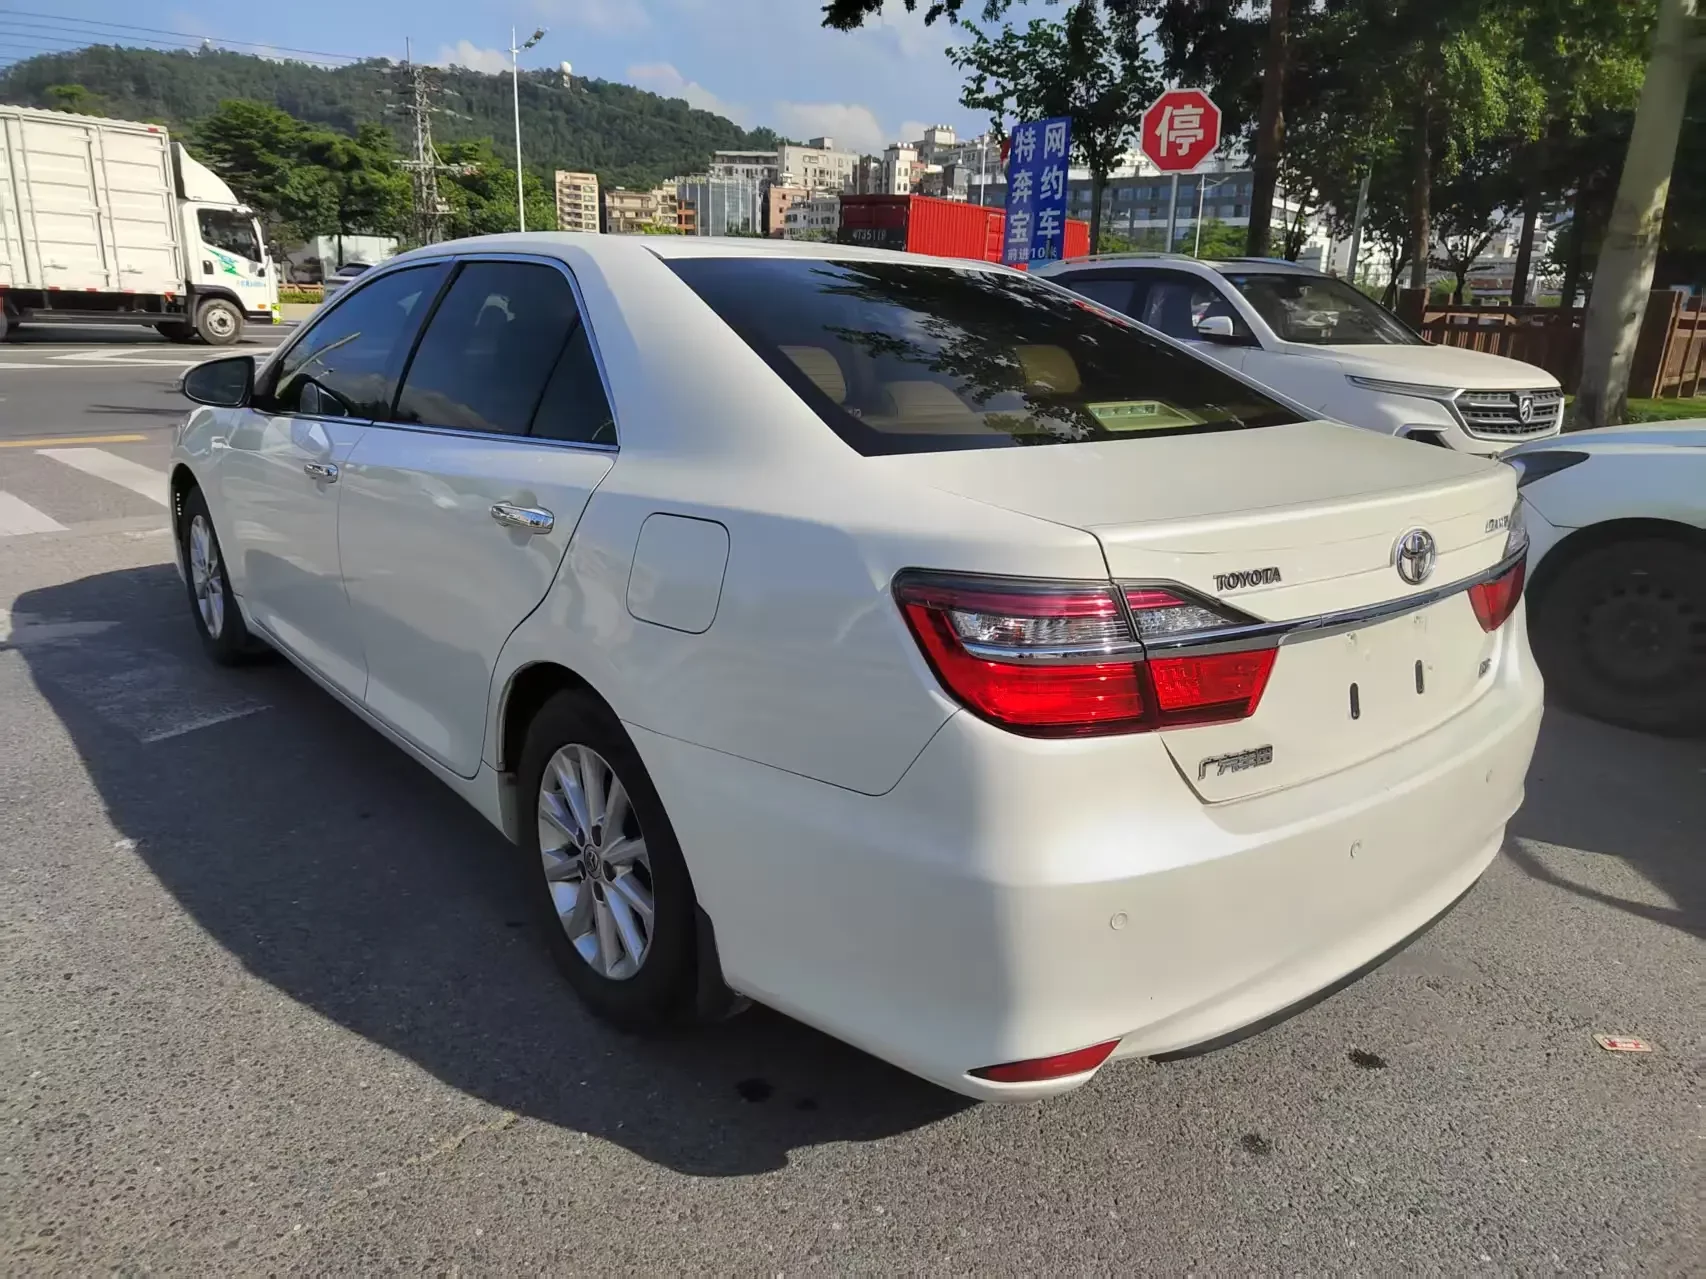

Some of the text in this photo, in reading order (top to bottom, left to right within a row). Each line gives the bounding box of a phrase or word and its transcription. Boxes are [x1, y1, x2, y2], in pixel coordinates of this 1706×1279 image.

[1154, 104, 1205, 157] 停
[1008, 126, 1037, 244] 特奔宝
[1037, 121, 1067, 239] 网约车
[1213, 566, 1282, 592] TOYOTA
